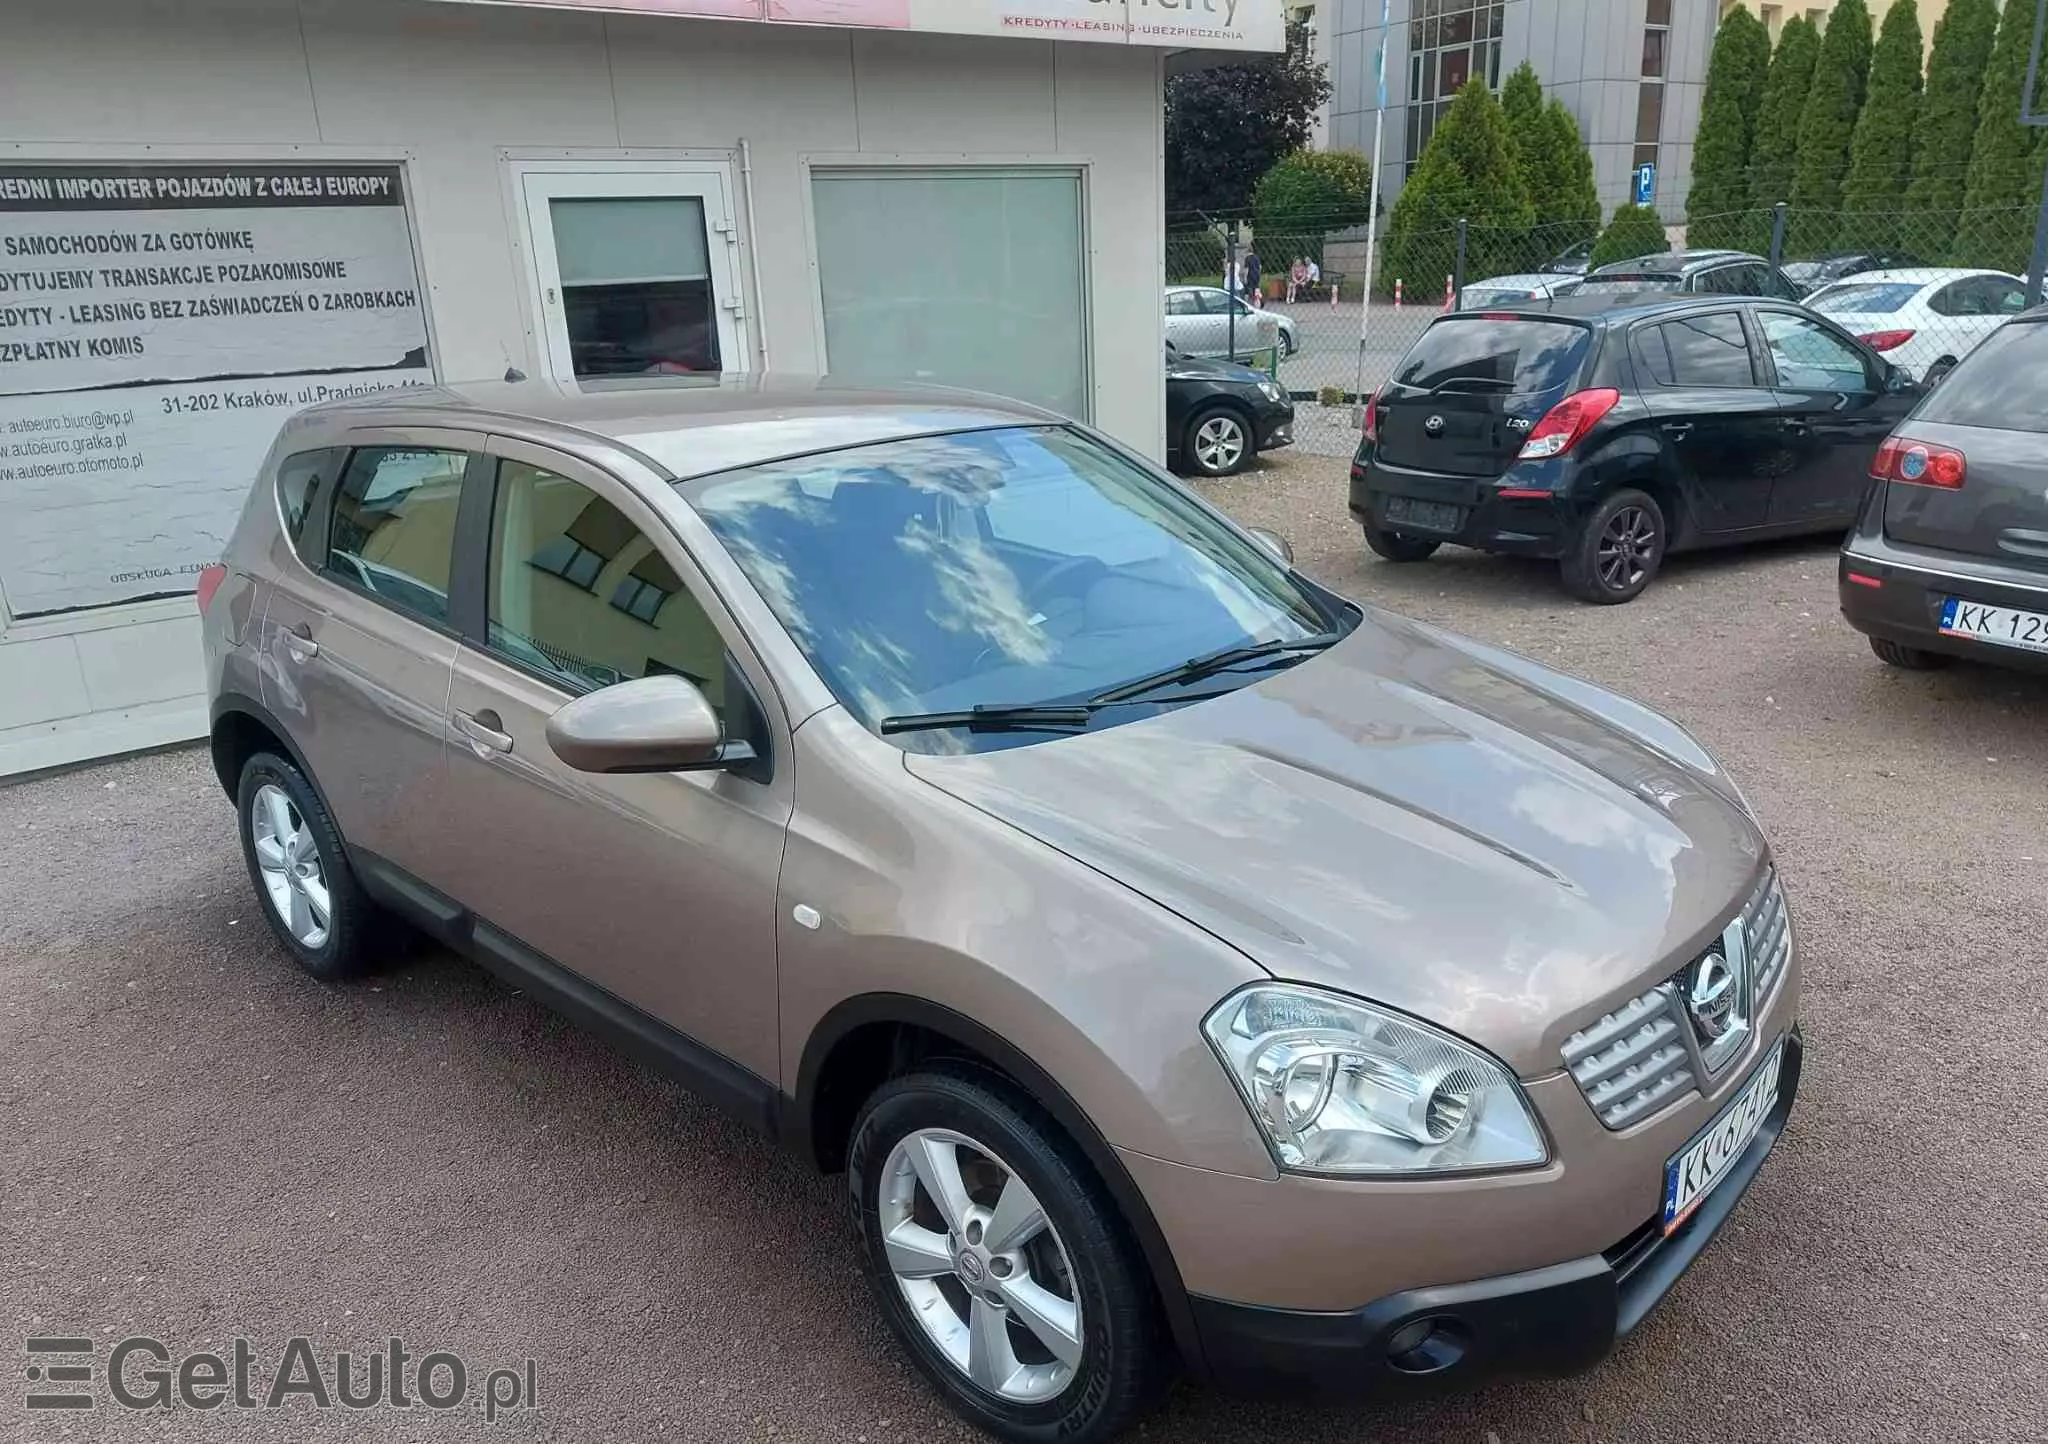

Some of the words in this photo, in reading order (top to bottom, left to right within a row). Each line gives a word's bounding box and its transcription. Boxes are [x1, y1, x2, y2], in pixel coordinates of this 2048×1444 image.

[1003, 15, 1068, 29] KREDYTY
[1142, 26, 1244, 40] UBEZPIECZENIA
[56, 177, 152, 199] IMPORTER
[156, 174, 252, 198] POJAZDÓW
[255, 177, 268, 197] Z
[270, 177, 322, 196] CAŁEJ
[326, 176, 389, 196] EUROPY
[1641, 167, 1650, 192] P
[5, 229, 137, 256] SAMOCHODÓW
[142, 233, 166, 252] ZA
[170, 227, 254, 253] GOTÓWKĘ
[0, 269, 94, 292] DYTUJEMY
[100, 264, 214, 288] TRANSAKCJE
[218, 261, 347, 283] POZAKOMISOWE
[69, 302, 146, 324] LEASING
[150, 300, 184, 320] BEZ
[189, 291, 304, 317] ZAŚWIADCZEŃ
[308, 294, 319, 311] O
[324, 290, 416, 311] ZAROBKACH
[0, 339, 81, 363] ZPŁATNY
[87, 336, 144, 357] KOMIS
[162, 392, 219, 415] 31-202
[223, 389, 293, 409] Kraków,
[8, 409, 134, 434] autoeuro.biuro@wp.pl
[1960, 605, 1997, 634] KK
[1682, 1131, 1717, 1202] KK
